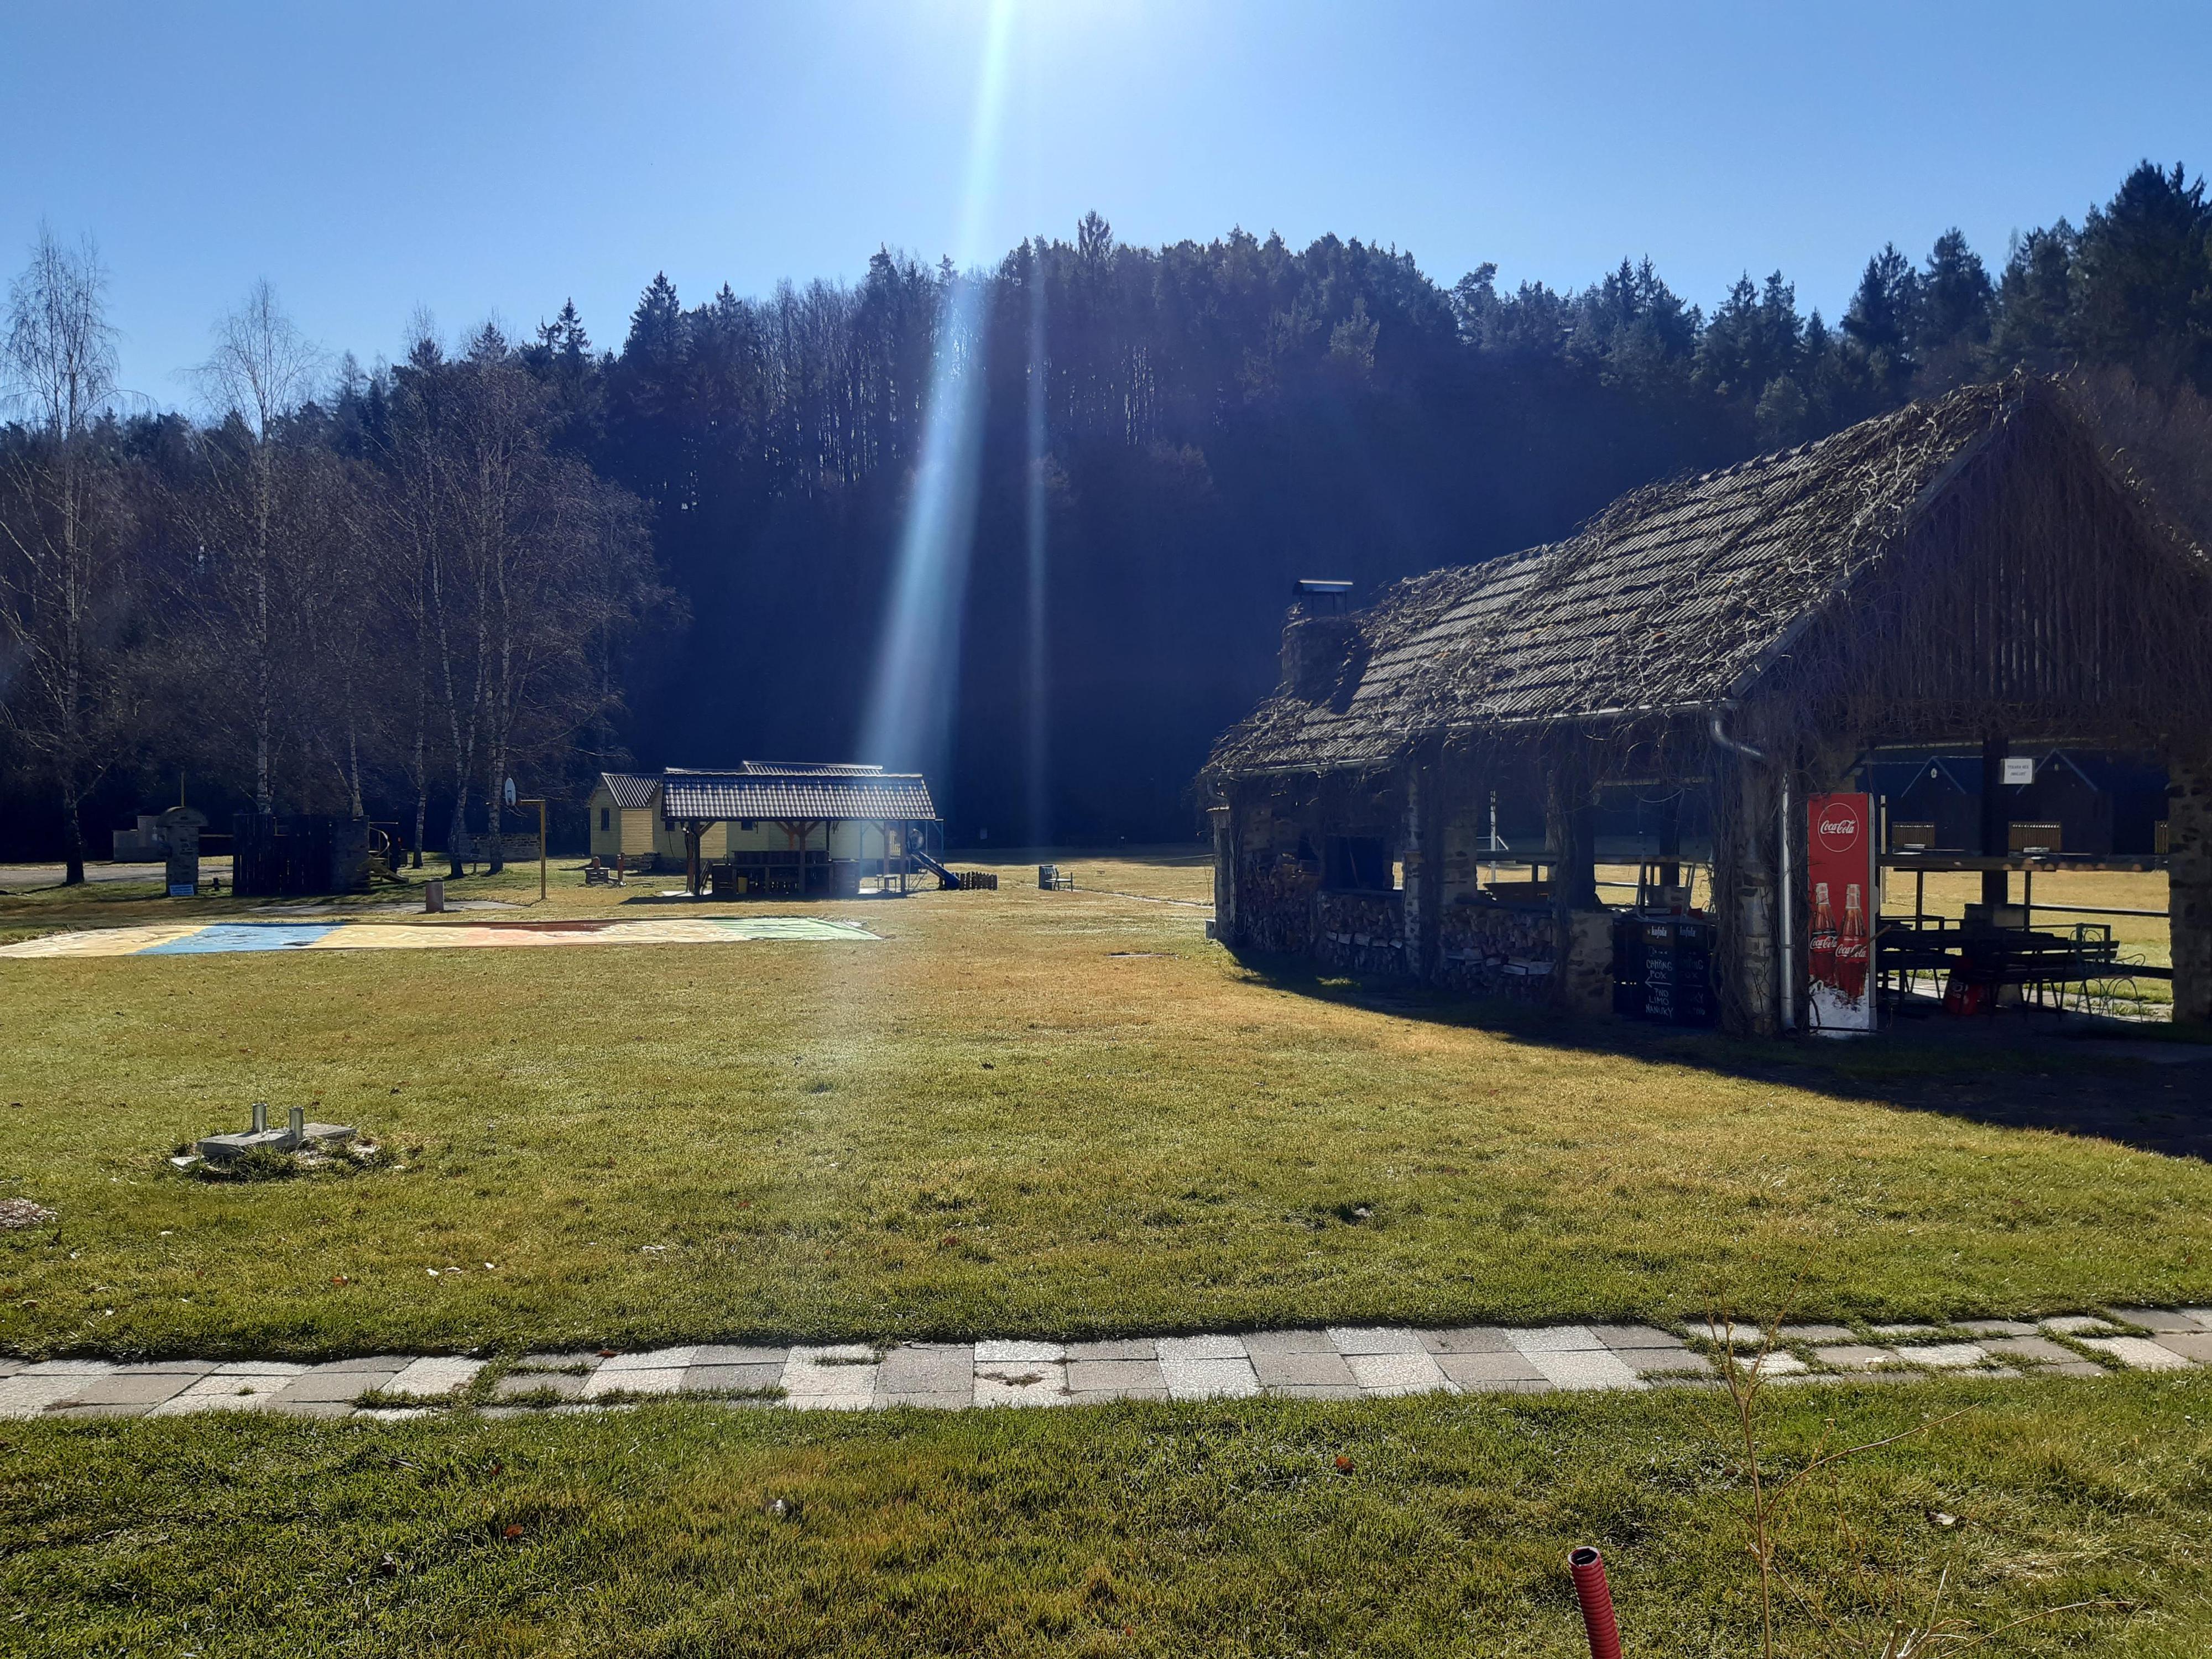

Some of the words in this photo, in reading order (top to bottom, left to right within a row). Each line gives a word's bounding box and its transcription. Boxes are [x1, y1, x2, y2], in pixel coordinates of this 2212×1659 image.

[1820, 820, 1856, 834] Coca-Cola
[1810, 935, 1838, 950] Coca-Cola
[1648, 995, 1670, 1005] LIMO
